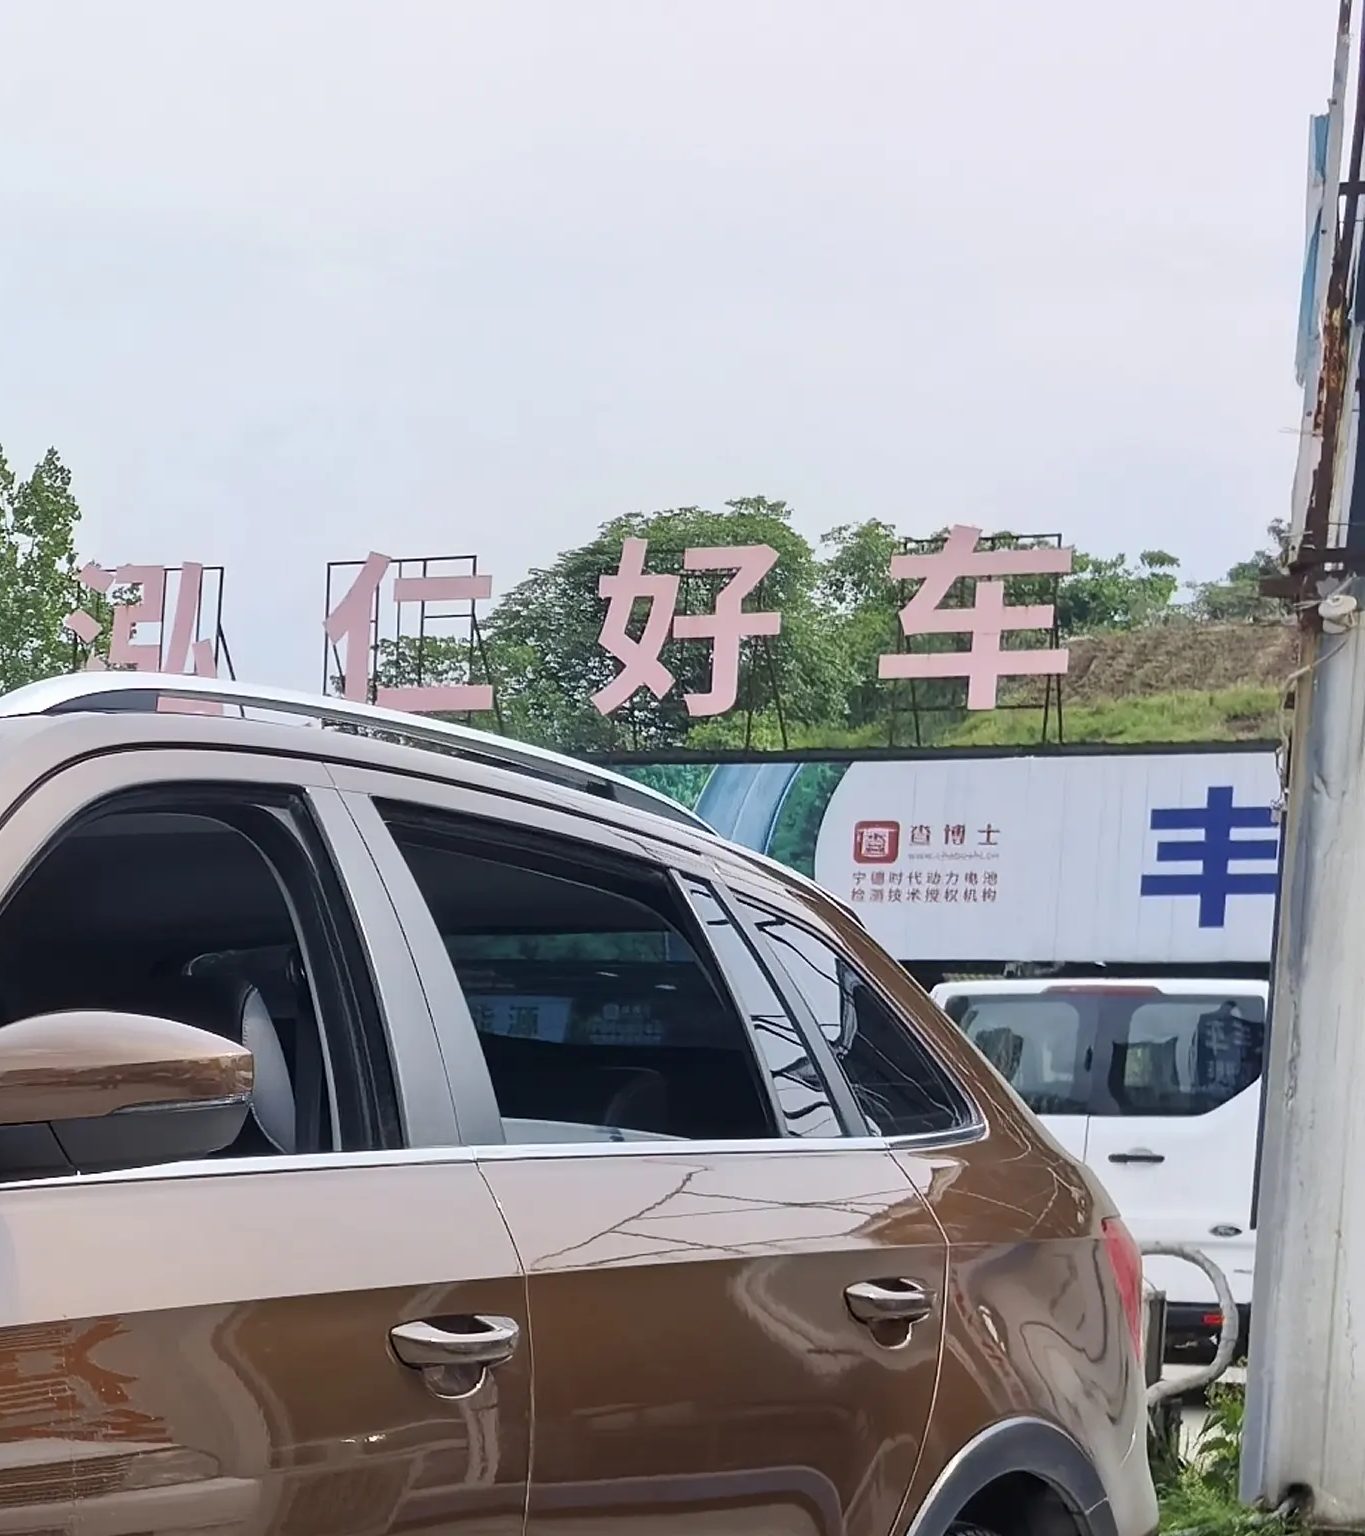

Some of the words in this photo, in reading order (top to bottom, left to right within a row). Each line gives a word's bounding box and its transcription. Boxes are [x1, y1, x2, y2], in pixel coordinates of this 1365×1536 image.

[1141, 786, 1279, 929] 丰
[852, 871, 998, 887] 宁德时代动力电池
[851, 888, 997, 904] 检测技术授权机构
